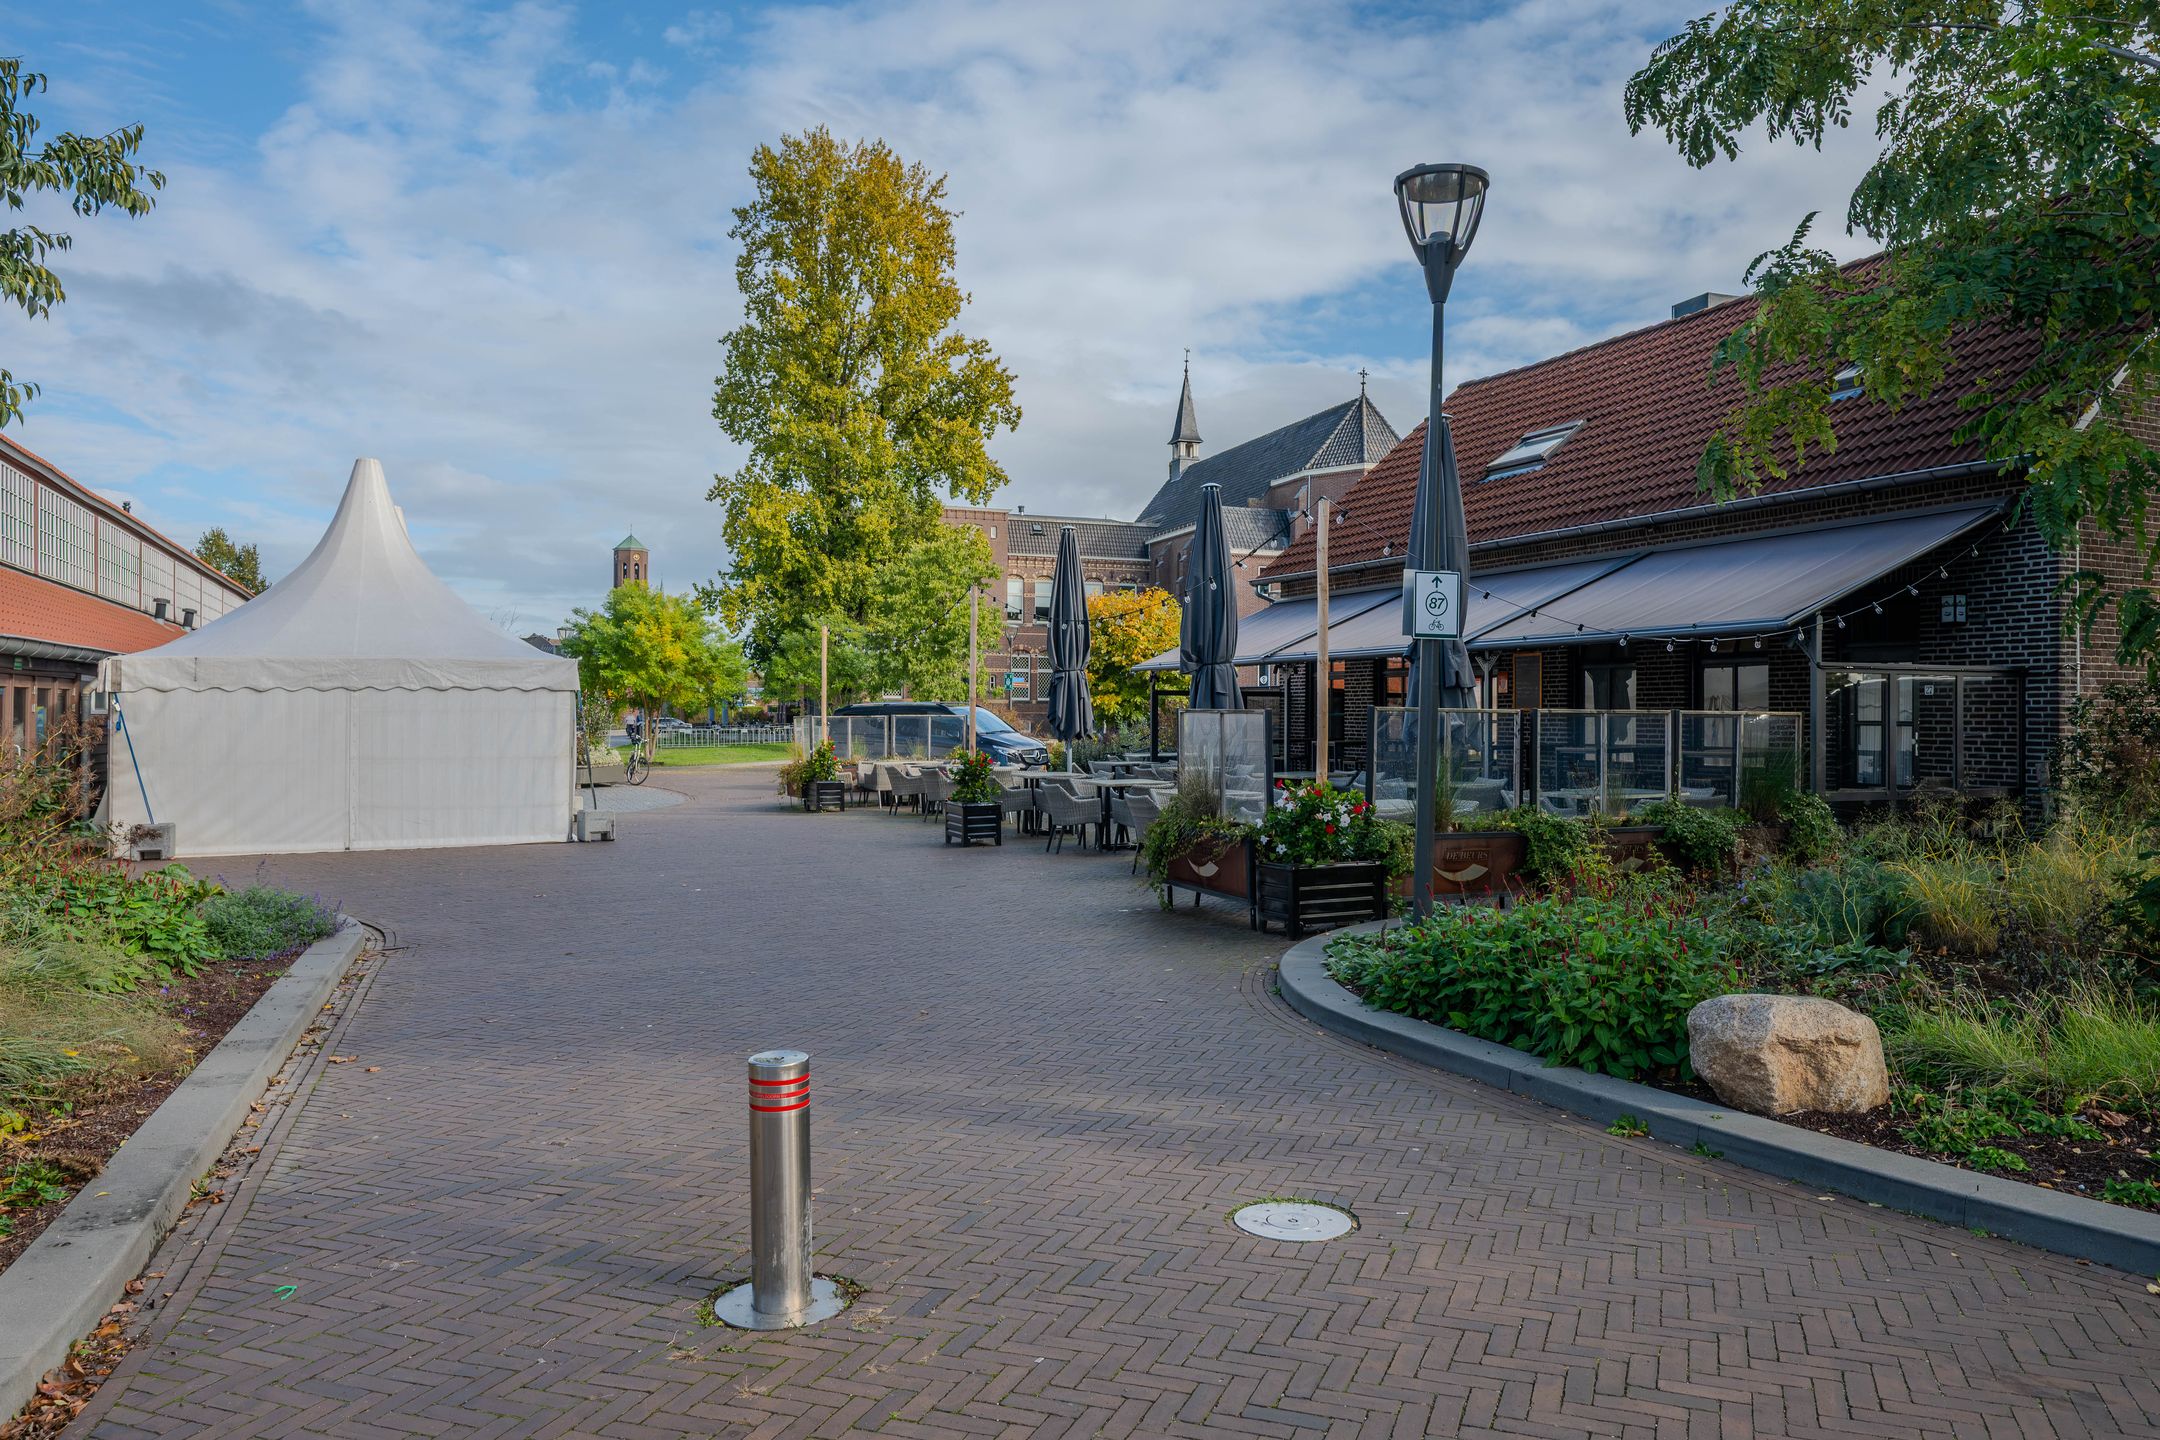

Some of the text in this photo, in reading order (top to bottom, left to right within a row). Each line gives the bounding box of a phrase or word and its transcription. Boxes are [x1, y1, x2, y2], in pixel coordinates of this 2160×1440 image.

[1429, 597, 1445, 609] 87
[1446, 851, 1488, 860] DE BEURS
